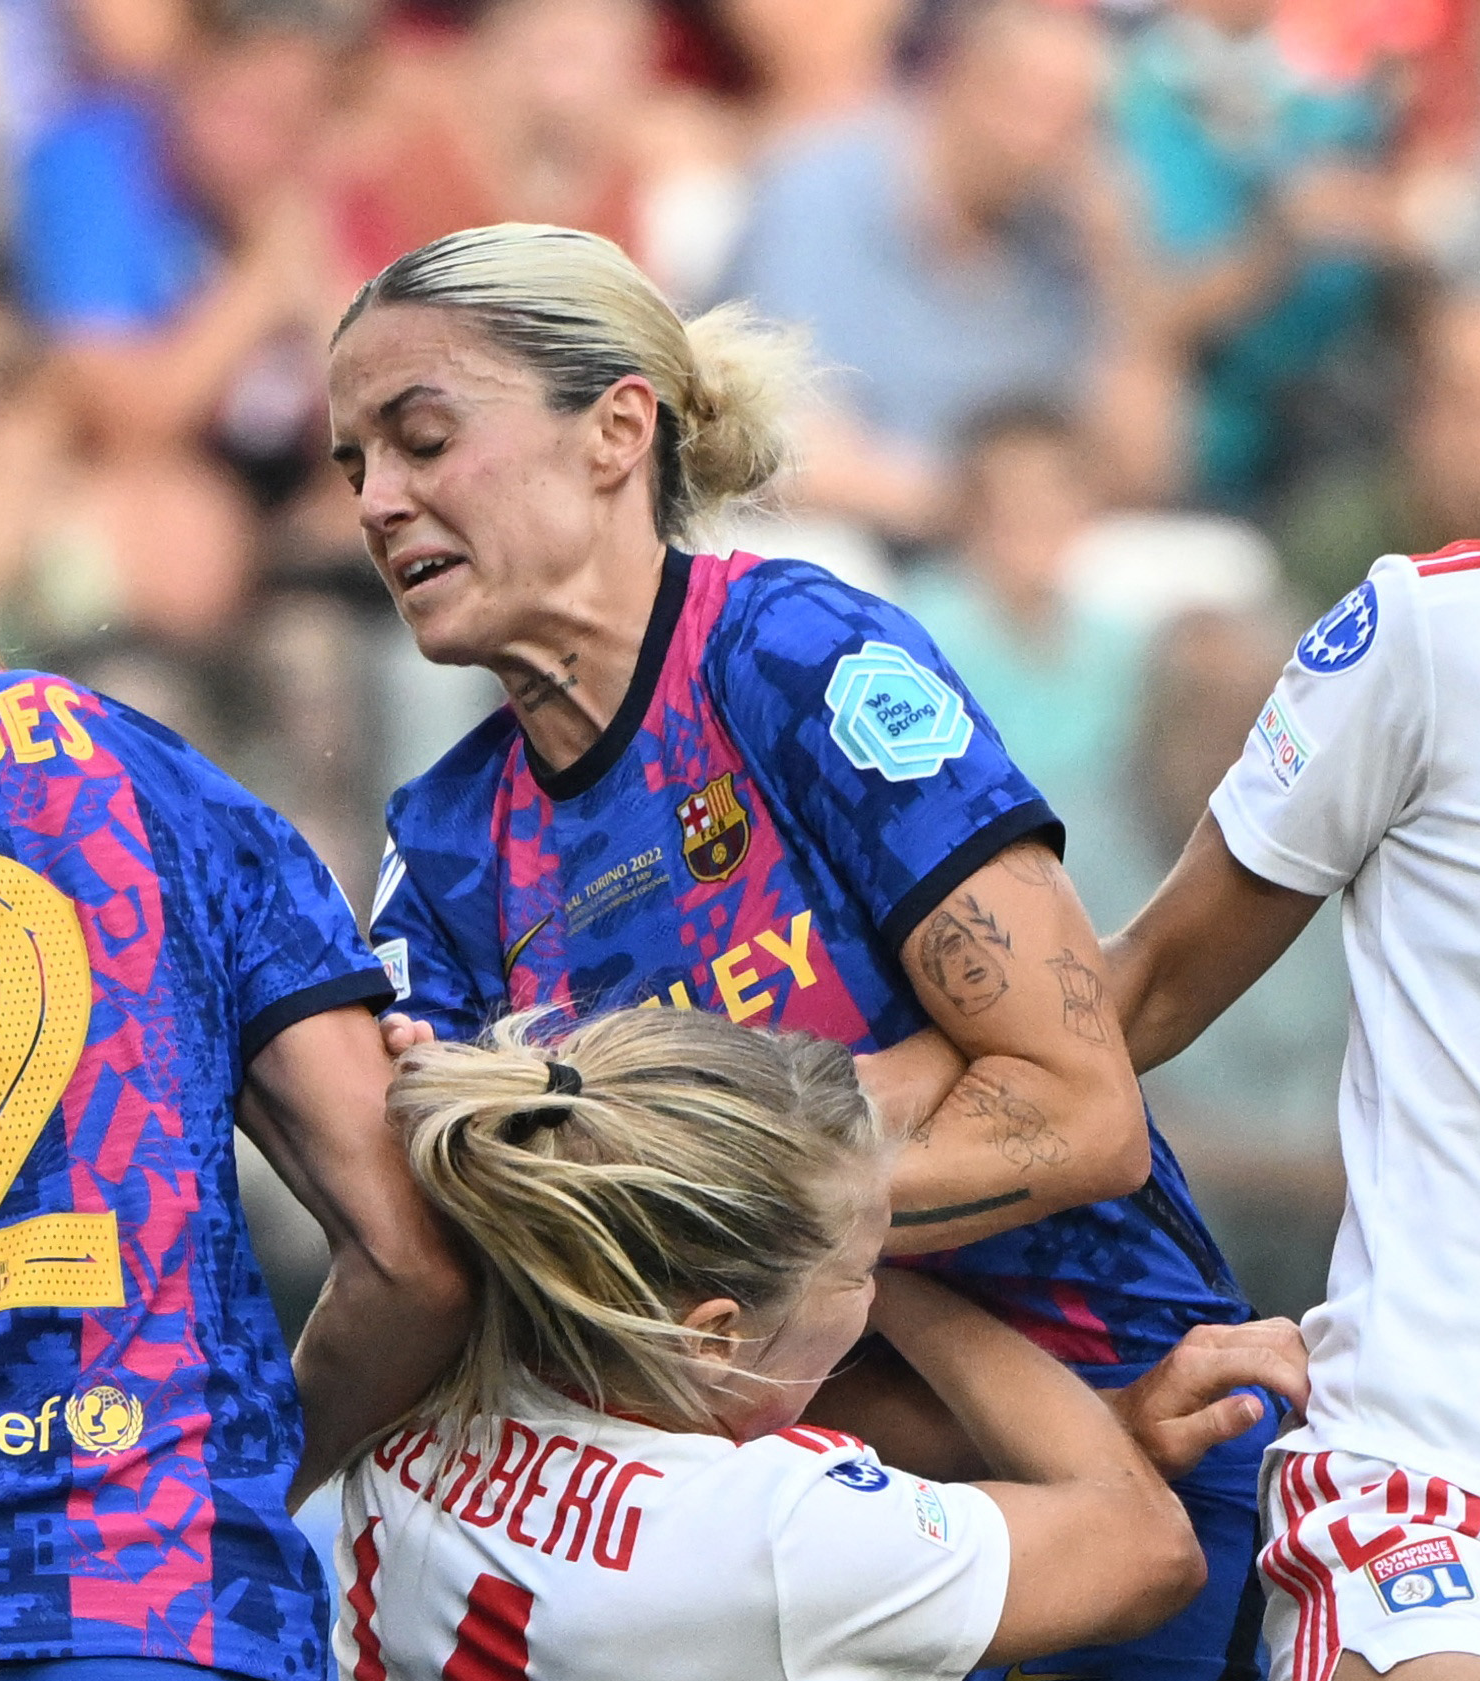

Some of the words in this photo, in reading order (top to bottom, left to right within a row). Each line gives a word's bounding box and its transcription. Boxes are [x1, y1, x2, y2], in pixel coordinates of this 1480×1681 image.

[865, 692, 891, 709] We
[876, 700, 912, 725] Play
[887, 703, 937, 738] Strong
[584, 863, 628, 899] TORINO
[629, 846, 663, 873] 2022
[1374, 1540, 1450, 1572] OLYMPIQUE
[1378, 1549, 1455, 1580] LYONNAIS
